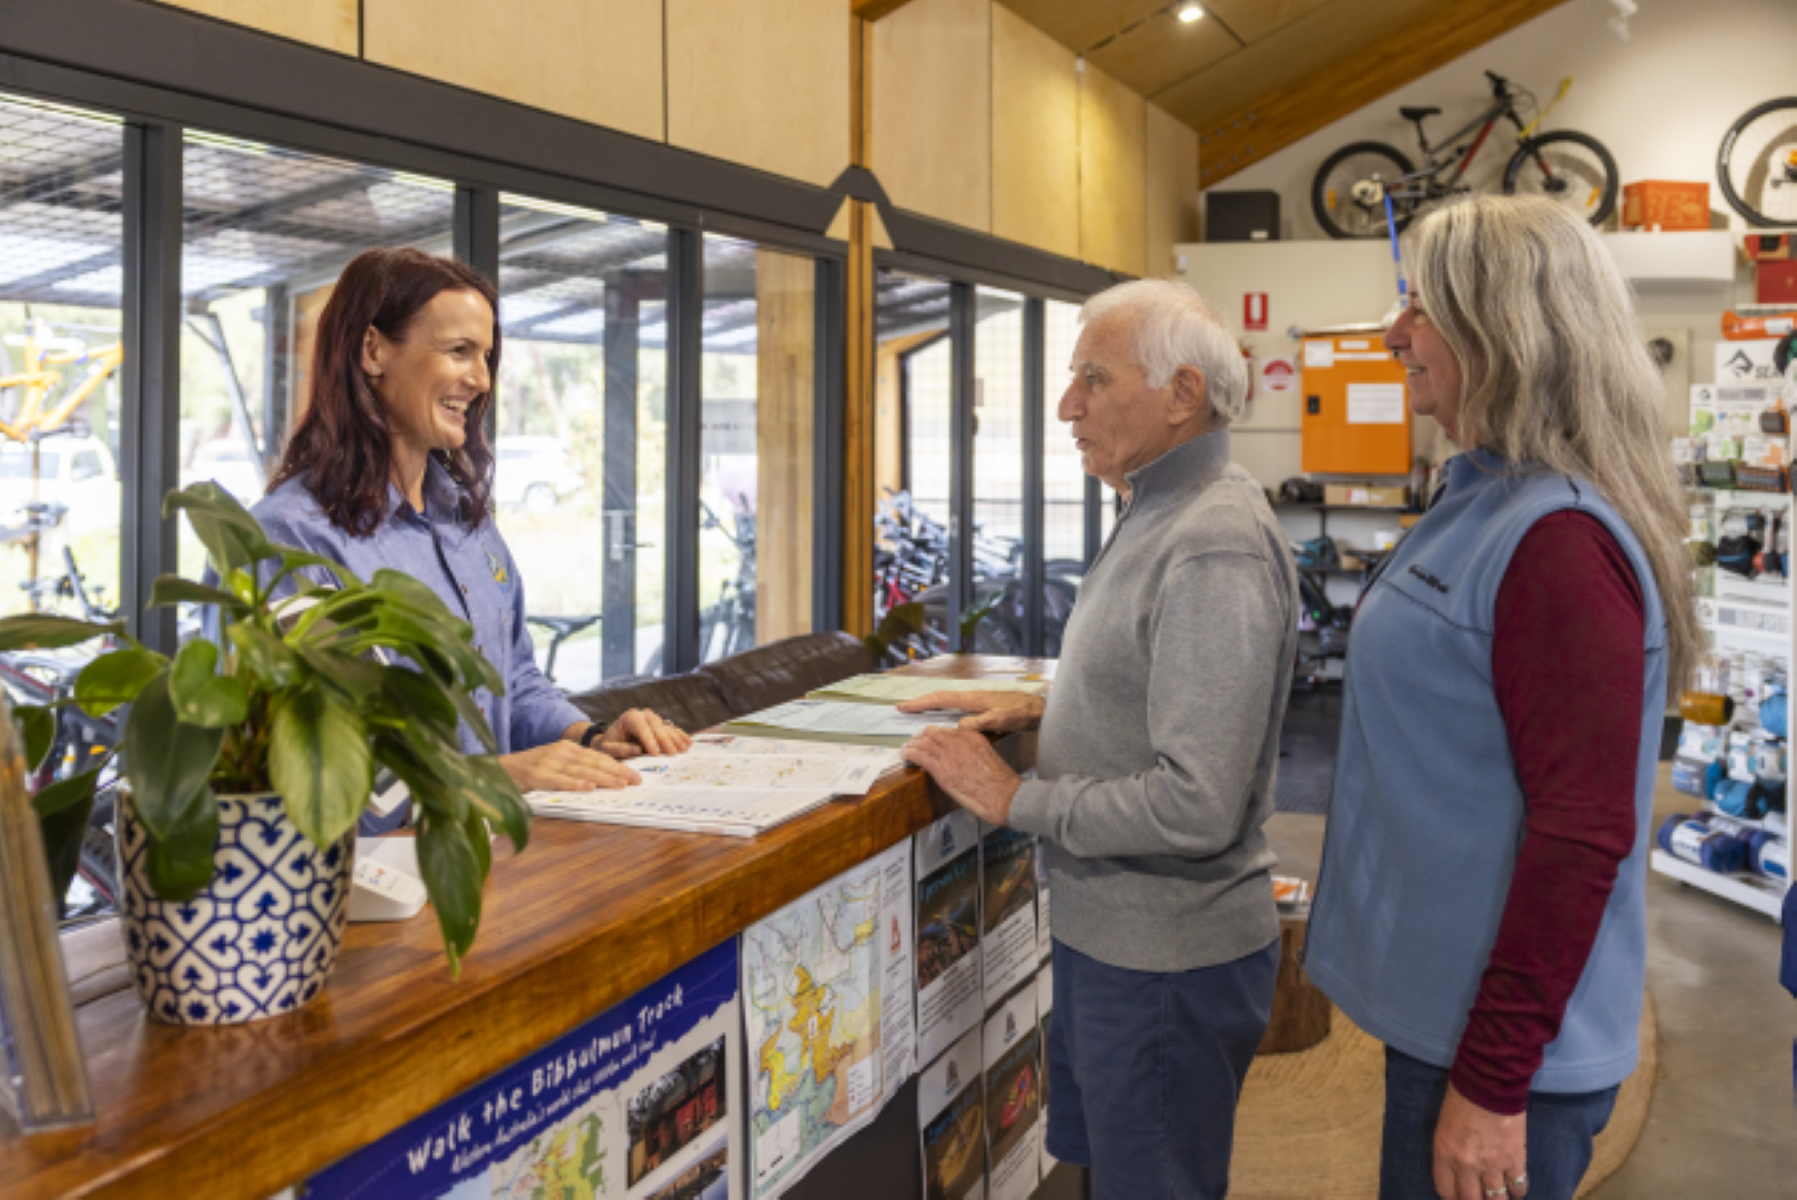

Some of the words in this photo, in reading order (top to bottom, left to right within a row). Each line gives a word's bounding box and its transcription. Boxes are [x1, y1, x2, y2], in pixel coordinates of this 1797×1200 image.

[407, 1114, 470, 1174] Walk
[483, 1087, 522, 1124] the
[532, 1024, 631, 1096] Bibbulmun
[636, 983, 684, 1034] Track
